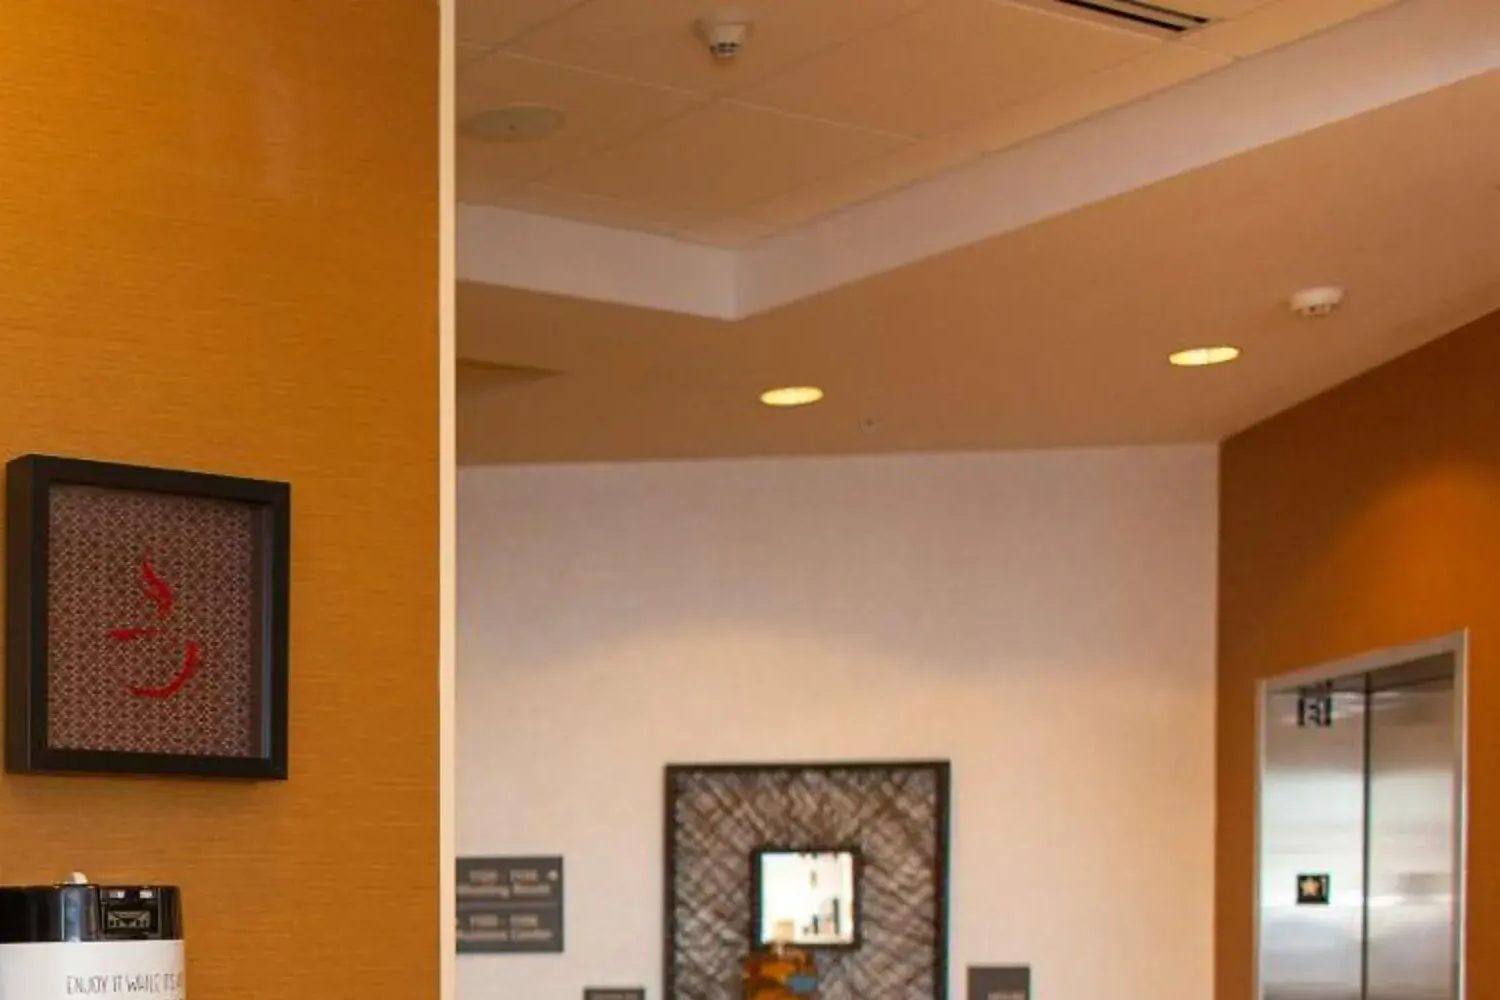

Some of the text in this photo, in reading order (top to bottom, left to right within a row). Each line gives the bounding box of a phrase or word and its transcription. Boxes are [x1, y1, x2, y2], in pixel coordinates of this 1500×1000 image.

[66, 975, 108, 995] ENJOY
[112, 975, 122, 993] IT
[125, 973, 160, 993] WHILE
